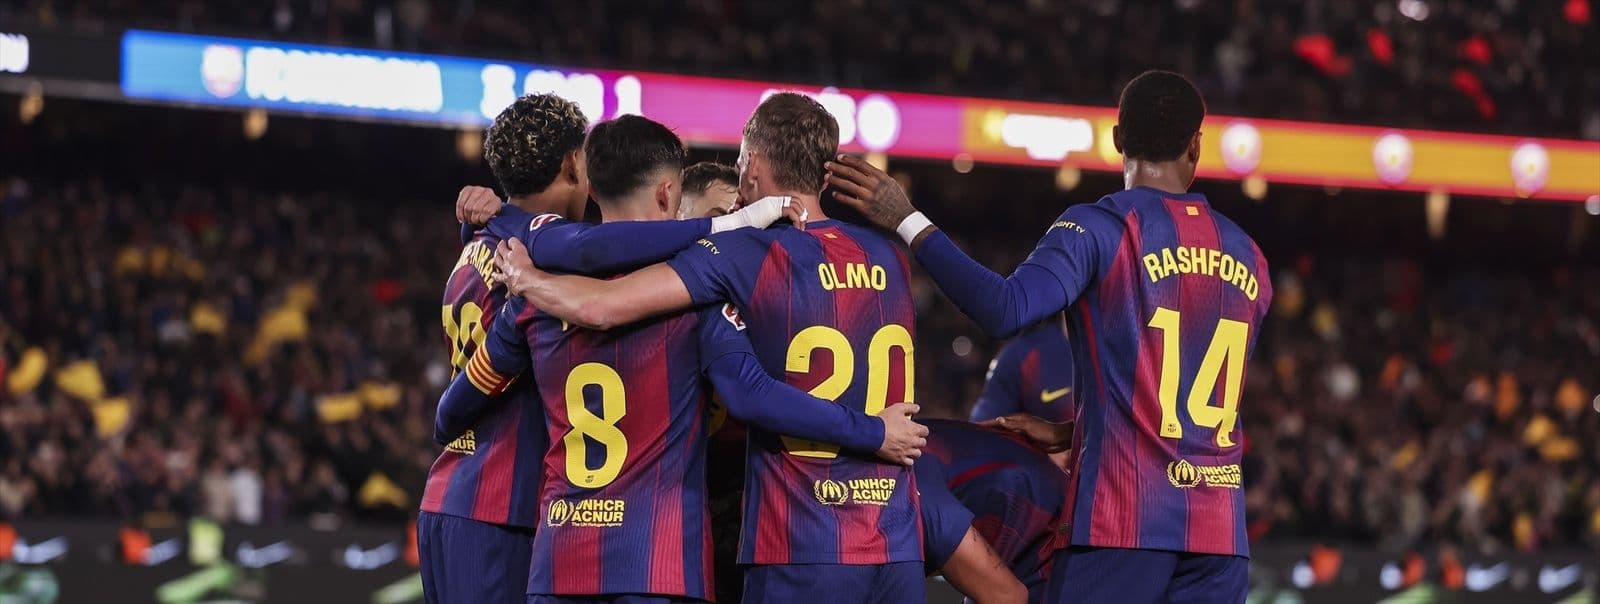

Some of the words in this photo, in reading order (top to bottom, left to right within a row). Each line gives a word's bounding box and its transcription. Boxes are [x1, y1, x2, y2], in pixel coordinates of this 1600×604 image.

[818, 262, 887, 291] OLMO
[1143, 246, 1259, 301] RASHFORD
[785, 324, 915, 459] 20
[1147, 306, 1249, 447] 14
[563, 362, 628, 489] 8
[571, 510, 624, 522] ACNUR
